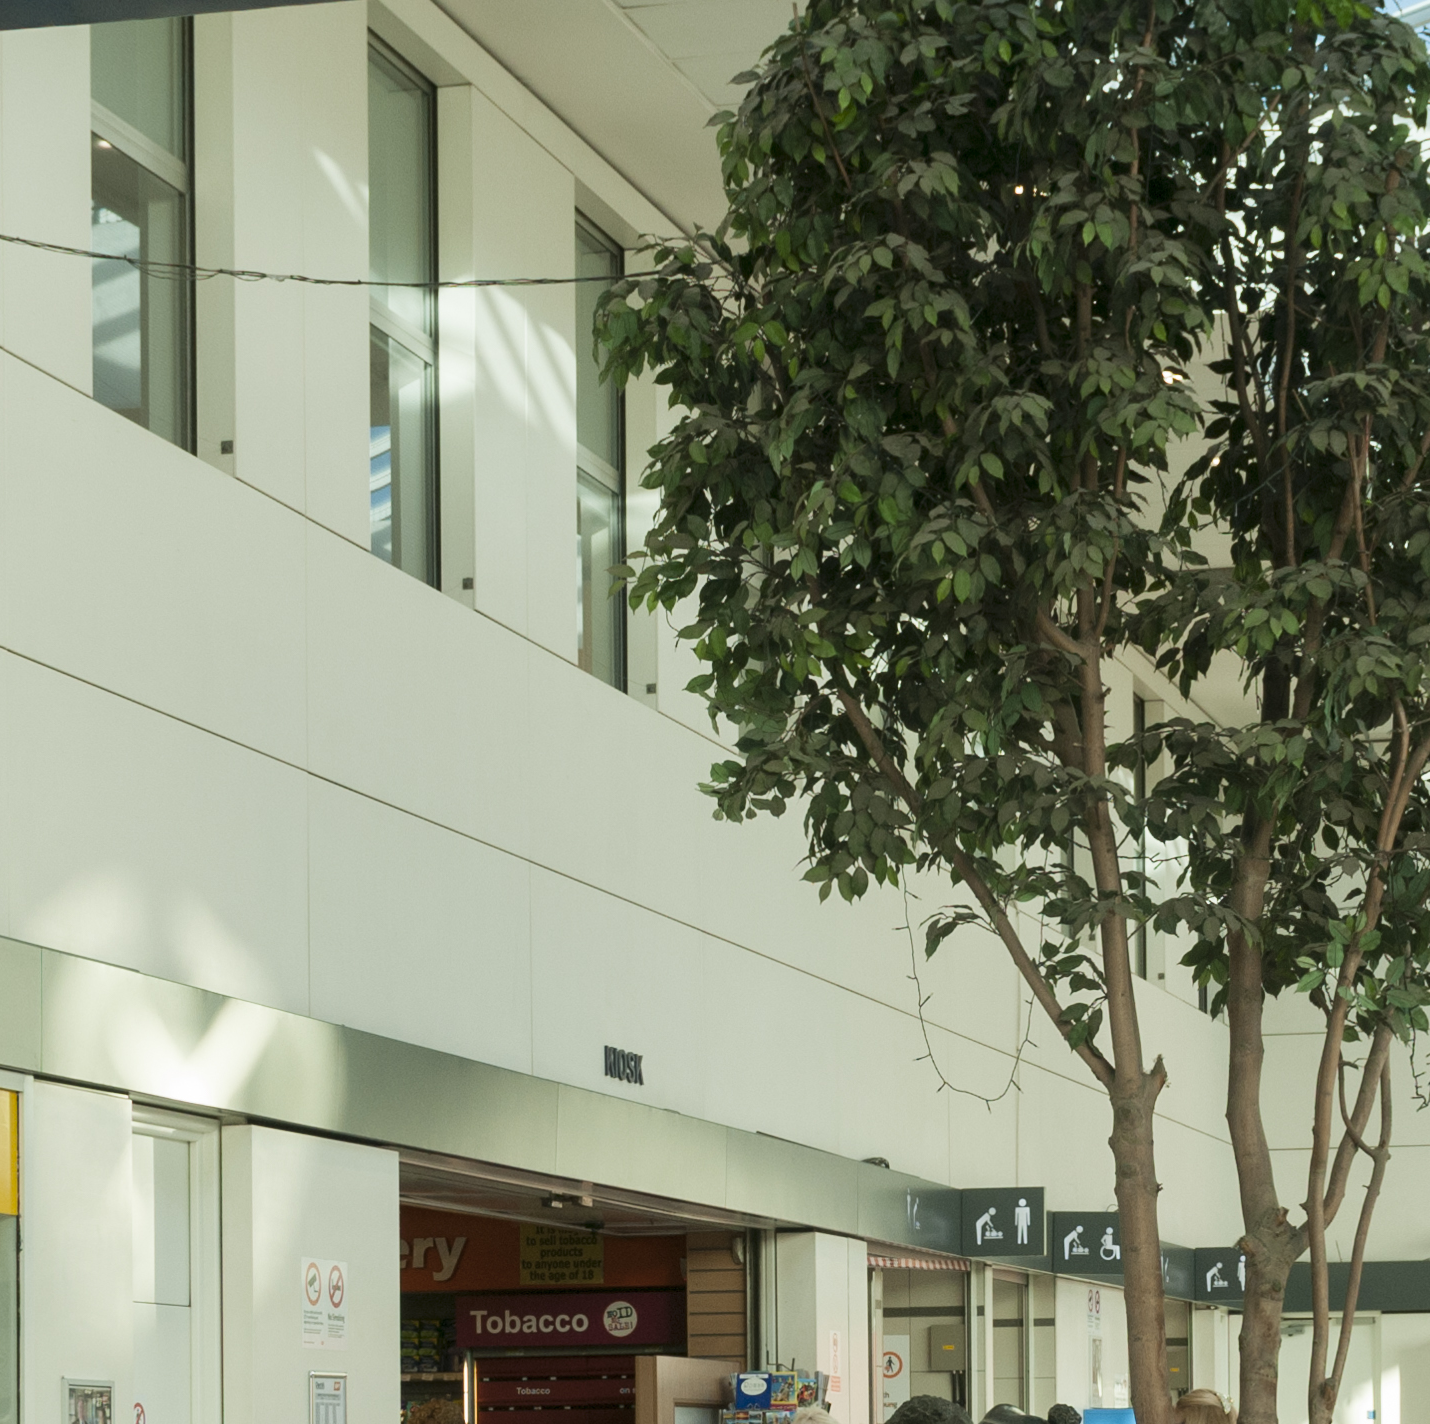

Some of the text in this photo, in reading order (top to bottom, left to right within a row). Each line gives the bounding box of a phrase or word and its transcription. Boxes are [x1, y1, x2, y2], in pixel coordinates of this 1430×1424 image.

[604, 1045, 644, 1086] KIOSK
[526, 1235, 598, 1246] to sell tobacco
[540, 1247, 583, 1259] products
[522, 1260, 602, 1272] to anyone under
[529, 1270, 594, 1283] the age of 18
[616, 1306, 633, 1319] ID
[469, 1309, 590, 1335] Tobacco
[516, 1386, 631, 1396] Tobacco on
